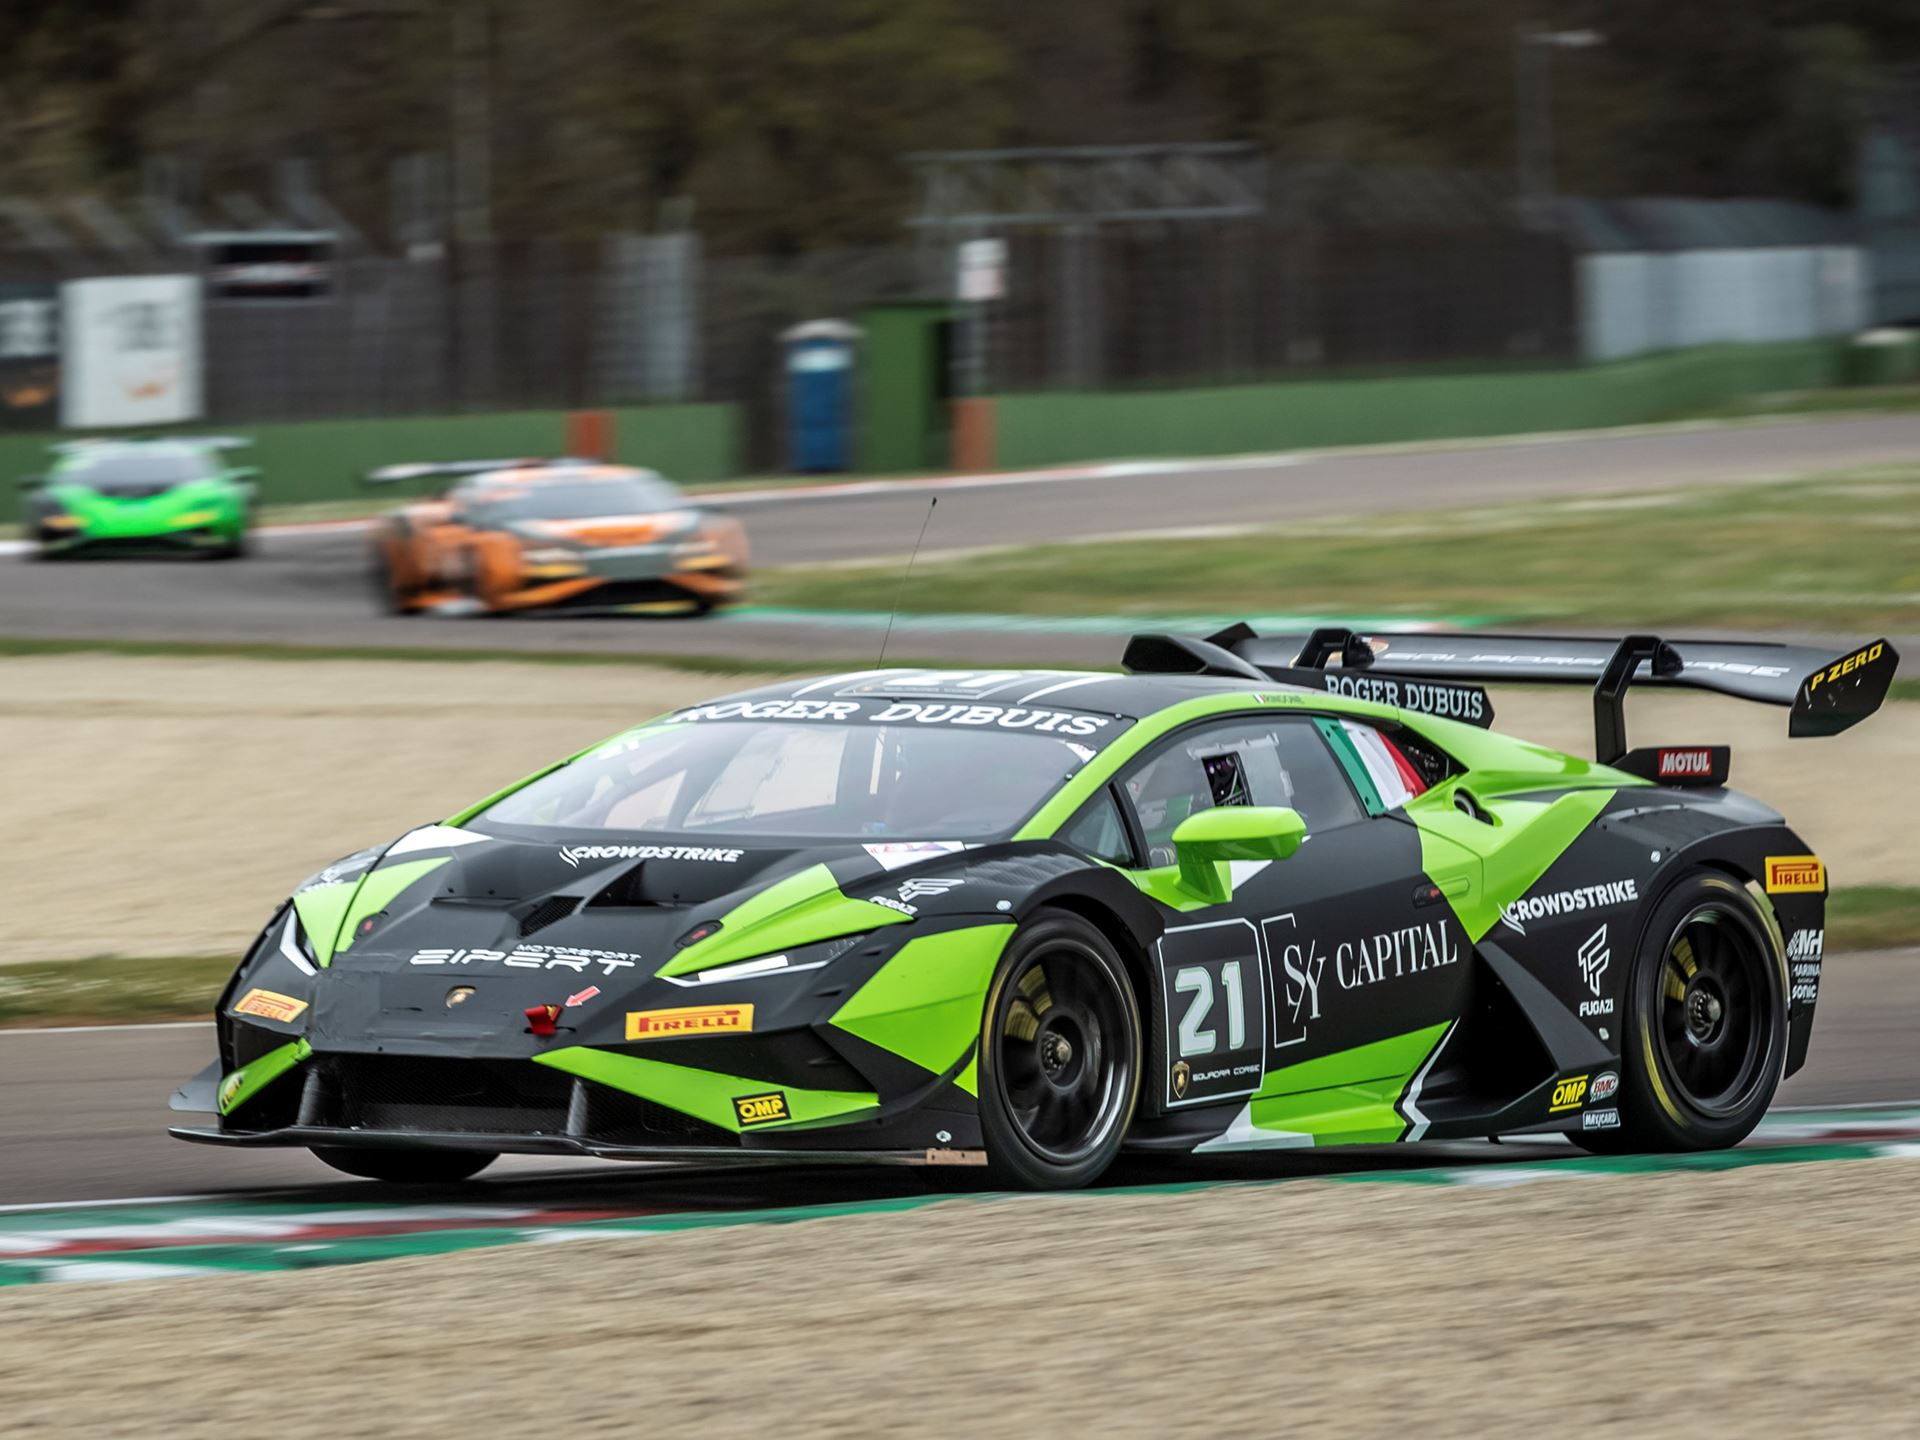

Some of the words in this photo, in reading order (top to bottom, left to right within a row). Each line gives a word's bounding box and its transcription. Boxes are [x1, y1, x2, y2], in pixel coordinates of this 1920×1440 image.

[1811, 674, 1824, 691] P
[1827, 643, 1883, 683] ZERO
[1325, 674, 1400, 707] ROGER
[1405, 683, 1483, 720] DUBUIS
[664, 700, 860, 724] ROGER
[869, 703, 1109, 735] DUBUIS
[1662, 752, 1710, 774] MOTUL
[571, 846, 745, 863] CROWDSTRIKE
[1771, 862, 1819, 886] PIRELLI
[1506, 879, 1638, 922] CROWDSTRIKE
[409, 949, 636, 975] EIPERT
[516, 944, 641, 962] MOTORSPORT
[1336, 920, 1458, 989] CAPITAL
[1174, 960, 1245, 1057] 21
[1579, 998, 1614, 1017] FUGAZI
[638, 1010, 740, 1033] PIRELLI
[1552, 1080, 1587, 1106] OMP
[1593, 1078, 1616, 1094] BMC
[739, 1098, 784, 1118] OMP
